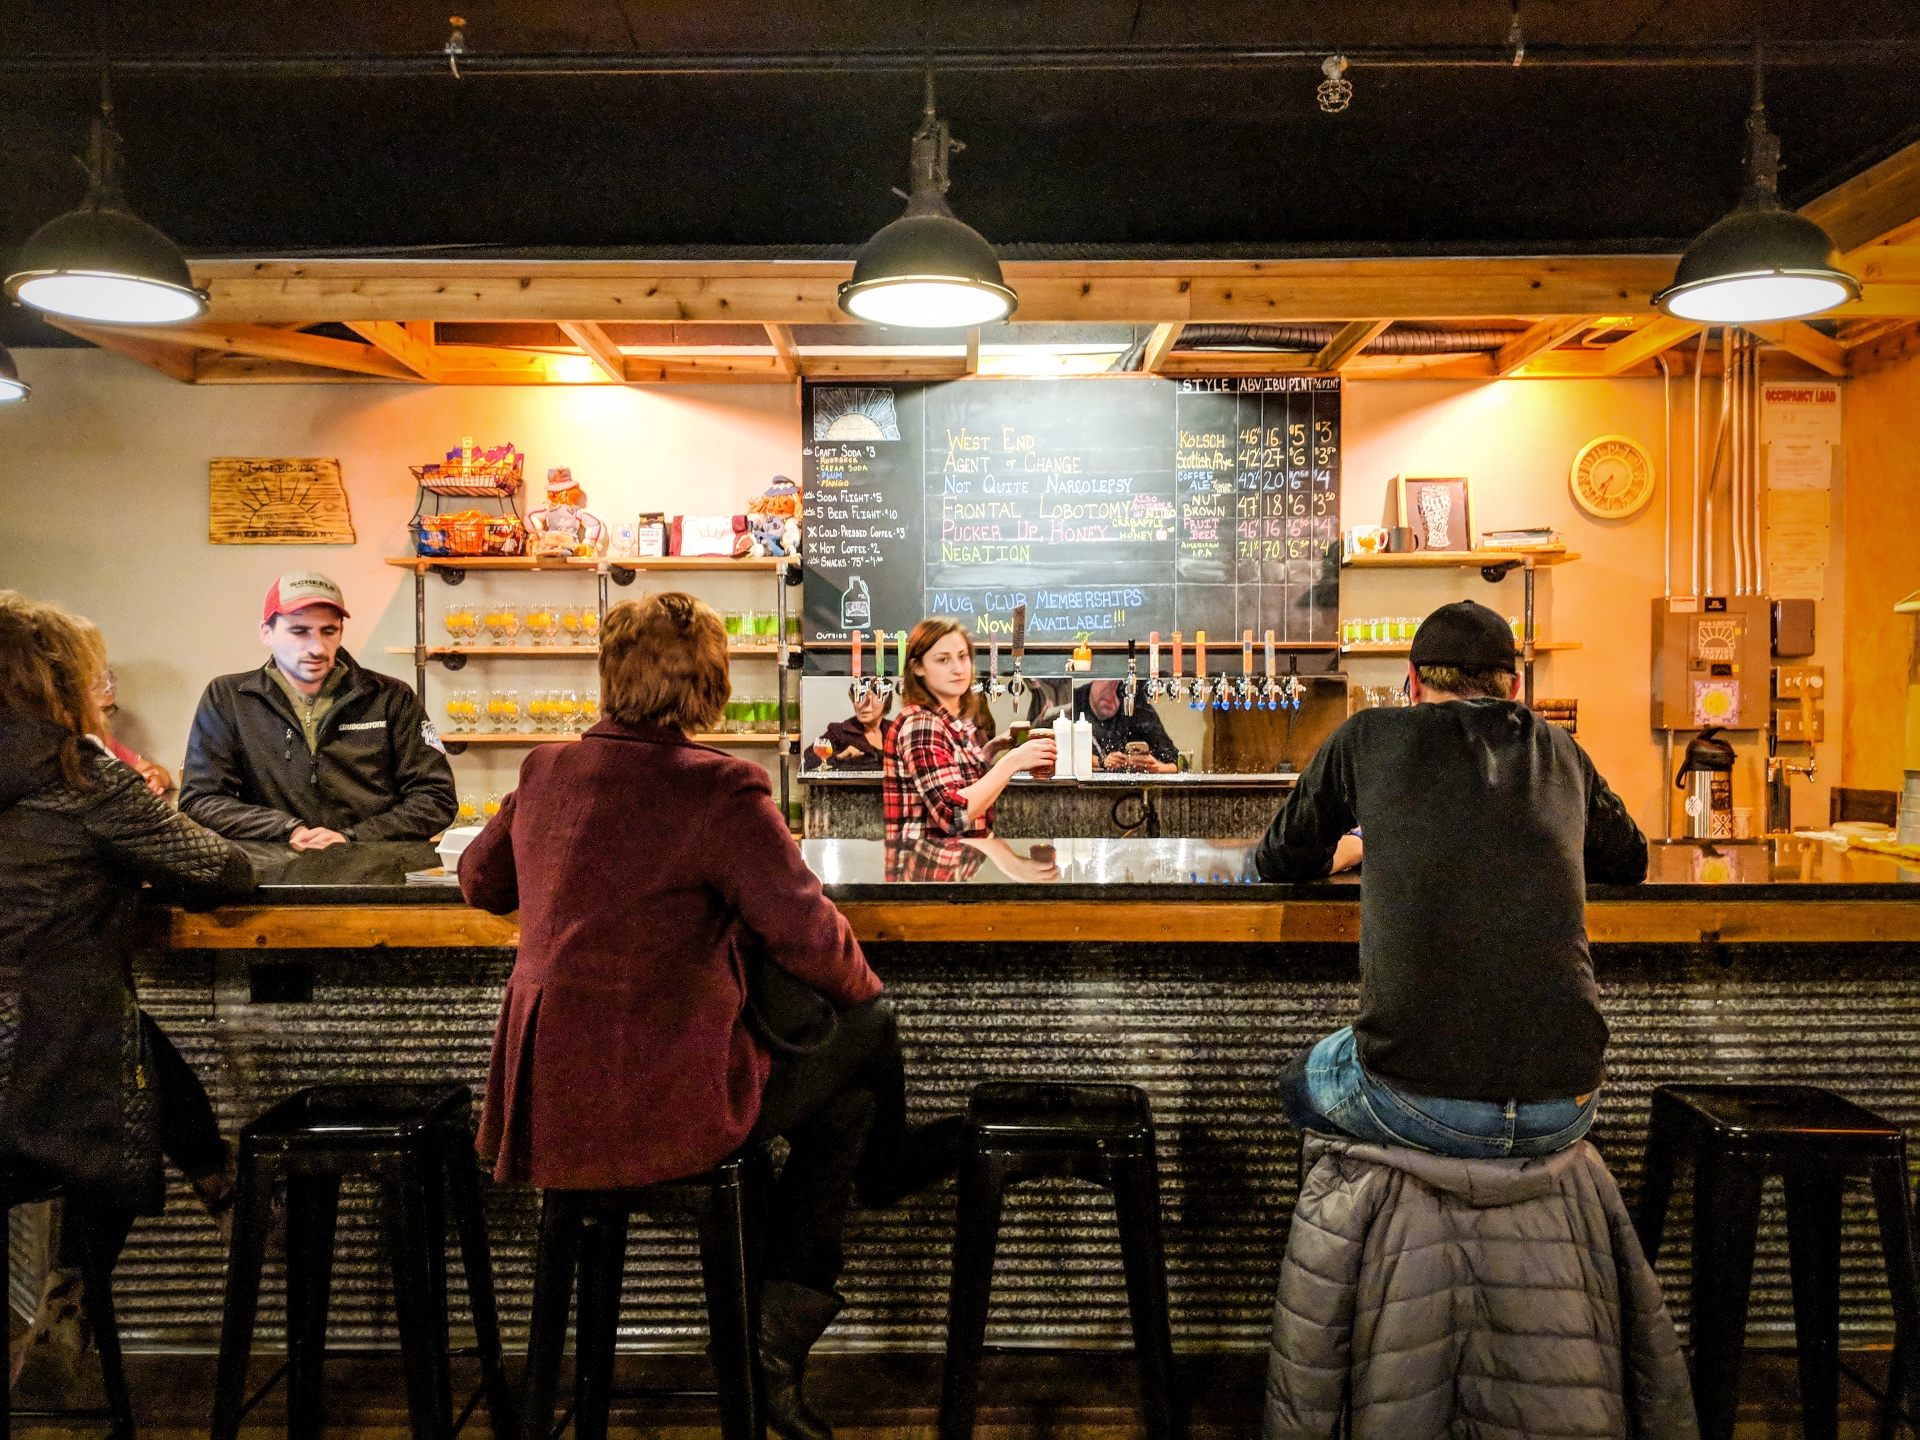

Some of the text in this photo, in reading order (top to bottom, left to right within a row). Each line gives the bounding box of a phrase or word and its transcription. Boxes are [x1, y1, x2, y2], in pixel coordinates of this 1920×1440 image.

[1183, 378, 1230, 392] STYLE
[1240, 379, 1262, 391] ABV
[1264, 379, 1286, 391] IBU
[1289, 378, 1313, 391] PINT
[1322, 377, 1340, 389] PINT
[1765, 389, 1837, 403] OCCUPANCY LOAD
[946, 427, 1035, 451] WEST END
[1180, 430, 1225, 448] KÖLSCH
[1266, 427, 1279, 447] 16
[814, 446, 837, 457] CRAFT
[841, 444, 862, 458] SODA
[1263, 448, 1284, 468] 27
[1289, 447, 1305, 466] $6
[847, 464, 868, 472] SODA
[943, 451, 1082, 473] AGENT OF CHANGE
[821, 479, 849, 487] MANGO
[942, 473, 1133, 495] NOT QUITE NARCOLEPSY
[1178, 472, 1213, 481] COFFEE
[1263, 471, 1284, 491] 20
[1190, 480, 1211, 490] ALE
[816, 490, 838, 503] SODA
[840, 490, 869, 503] FLIGHT
[1133, 495, 1157, 503] ALSO
[817, 507, 824, 519] 5
[828, 507, 848, 519] BEER
[852, 505, 881, 519] FLIGHT
[943, 495, 1131, 519] FRONTAL LOBOTOMY
[1183, 504, 1225, 517] BROWN
[1192, 494, 1221, 505] NUT
[1267, 494, 1283, 516] 18
[1112, 518, 1164, 528] CRABAPPLE
[1184, 517, 1219, 530] FRUIT
[1266, 519, 1281, 537] 16
[229, 530, 334, 539] BREWING COMPANY
[870, 526, 893, 538] COFFEE
[942, 519, 1003, 541] PUCKER
[1050, 519, 1108, 542] HONEY
[1119, 530, 1153, 541] HONEY
[1190, 530, 1219, 540] BEER
[820, 542, 835, 554] HOT
[841, 541, 867, 554] COFFEE
[940, 541, 1030, 563] NEGATION
[1181, 541, 1219, 549] AMERICAN
[1262, 540, 1280, 558] 70
[820, 556, 847, 568] SNACKS
[932, 589, 1142, 613] MUG CLUB MEMBERSHIPS
[976, 613, 1014, 634] NOW
[816, 632, 847, 640] OUTSIDE
[338, 721, 388, 731] BRIDGESTONE
